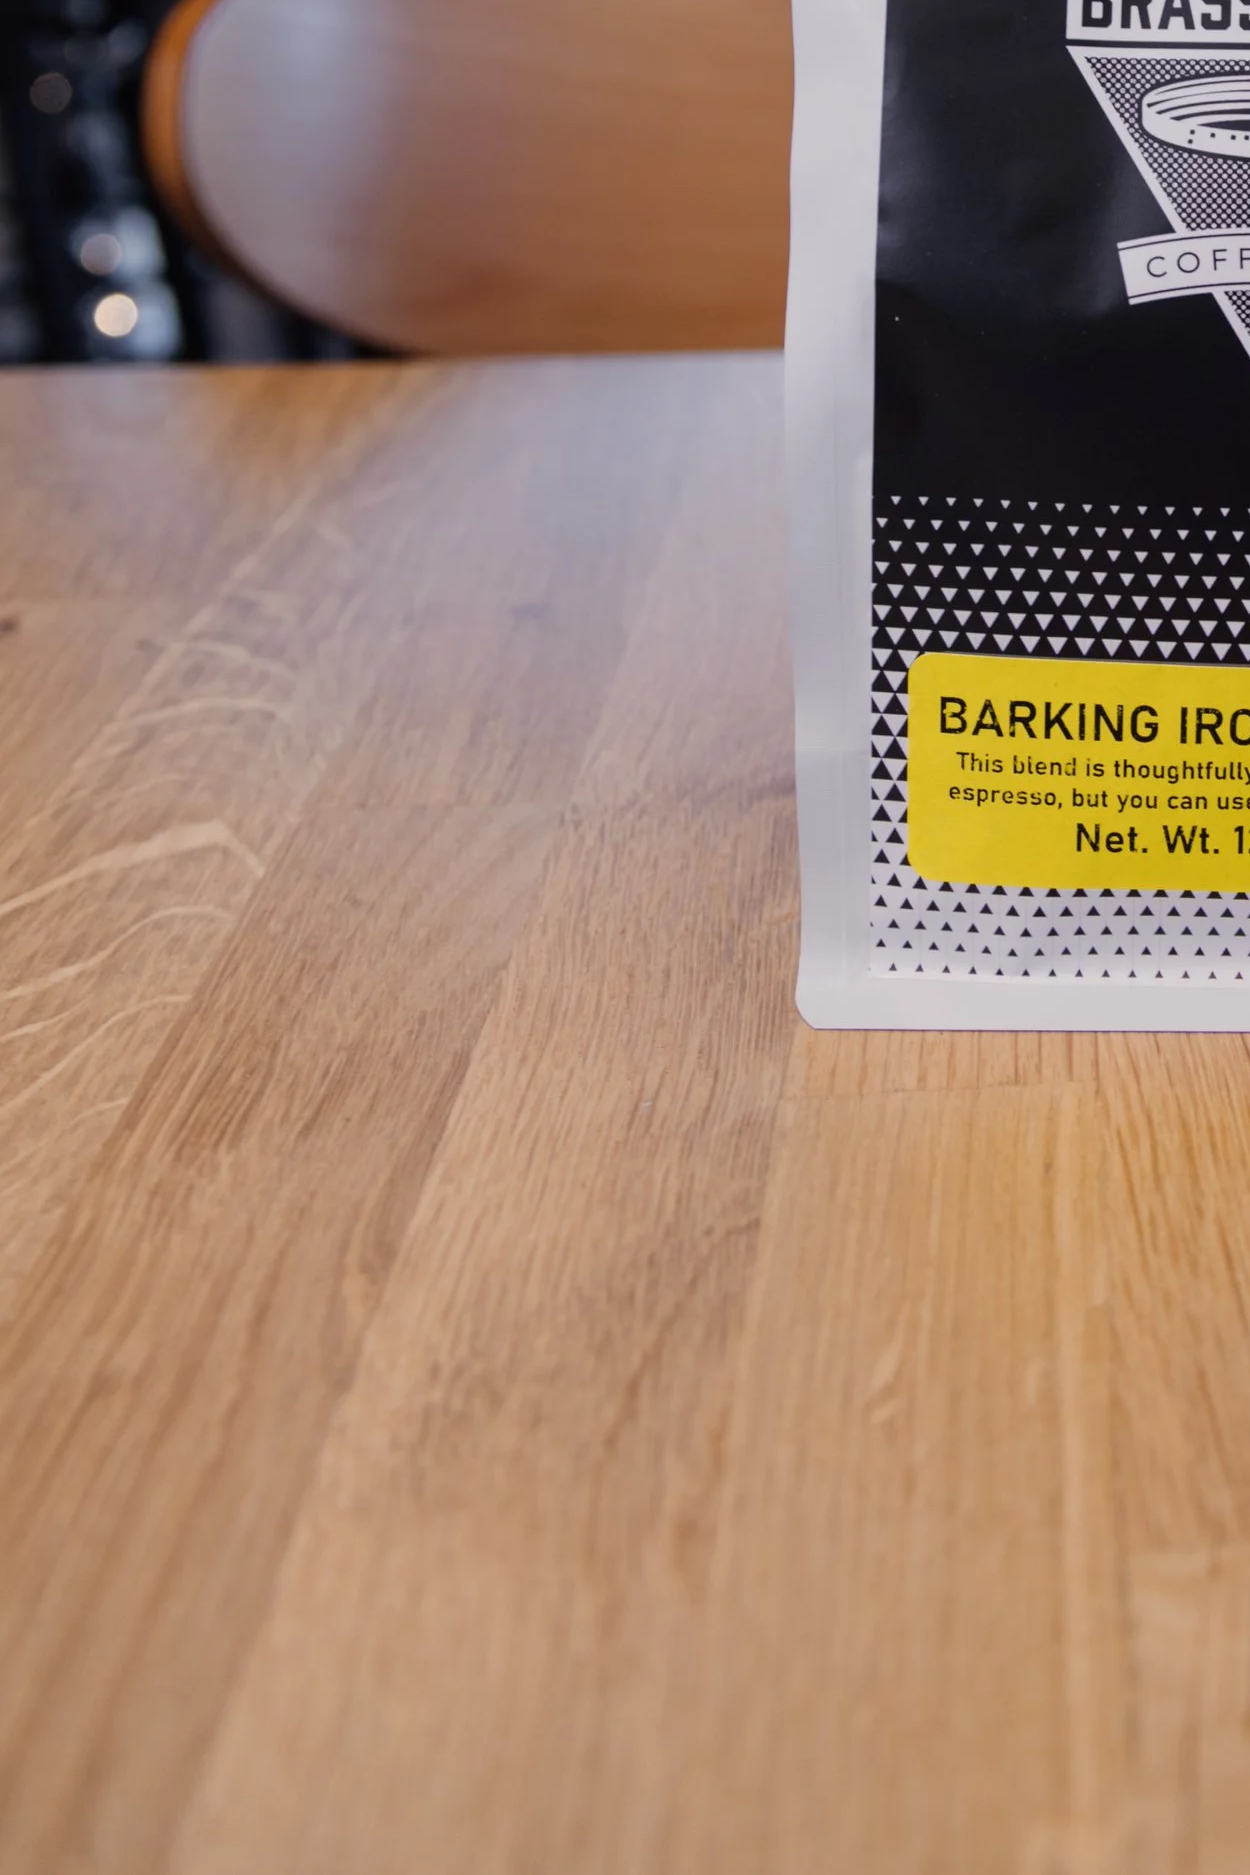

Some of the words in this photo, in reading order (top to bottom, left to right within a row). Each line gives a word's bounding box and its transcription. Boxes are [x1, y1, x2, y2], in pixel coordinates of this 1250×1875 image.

[940, 696, 1159, 744] BARKING
[956, 751, 1004, 774] This
[1013, 755, 1077, 777] blend
[1086, 757, 1105, 778] is
[948, 786, 1063, 810] espresso,
[1072, 788, 1108, 809] but
[1117, 794, 1158, 814] you
[1167, 795, 1208, 811] can
[1075, 822, 1148, 854] Net.
[1162, 824, 1220, 855] Wt.
